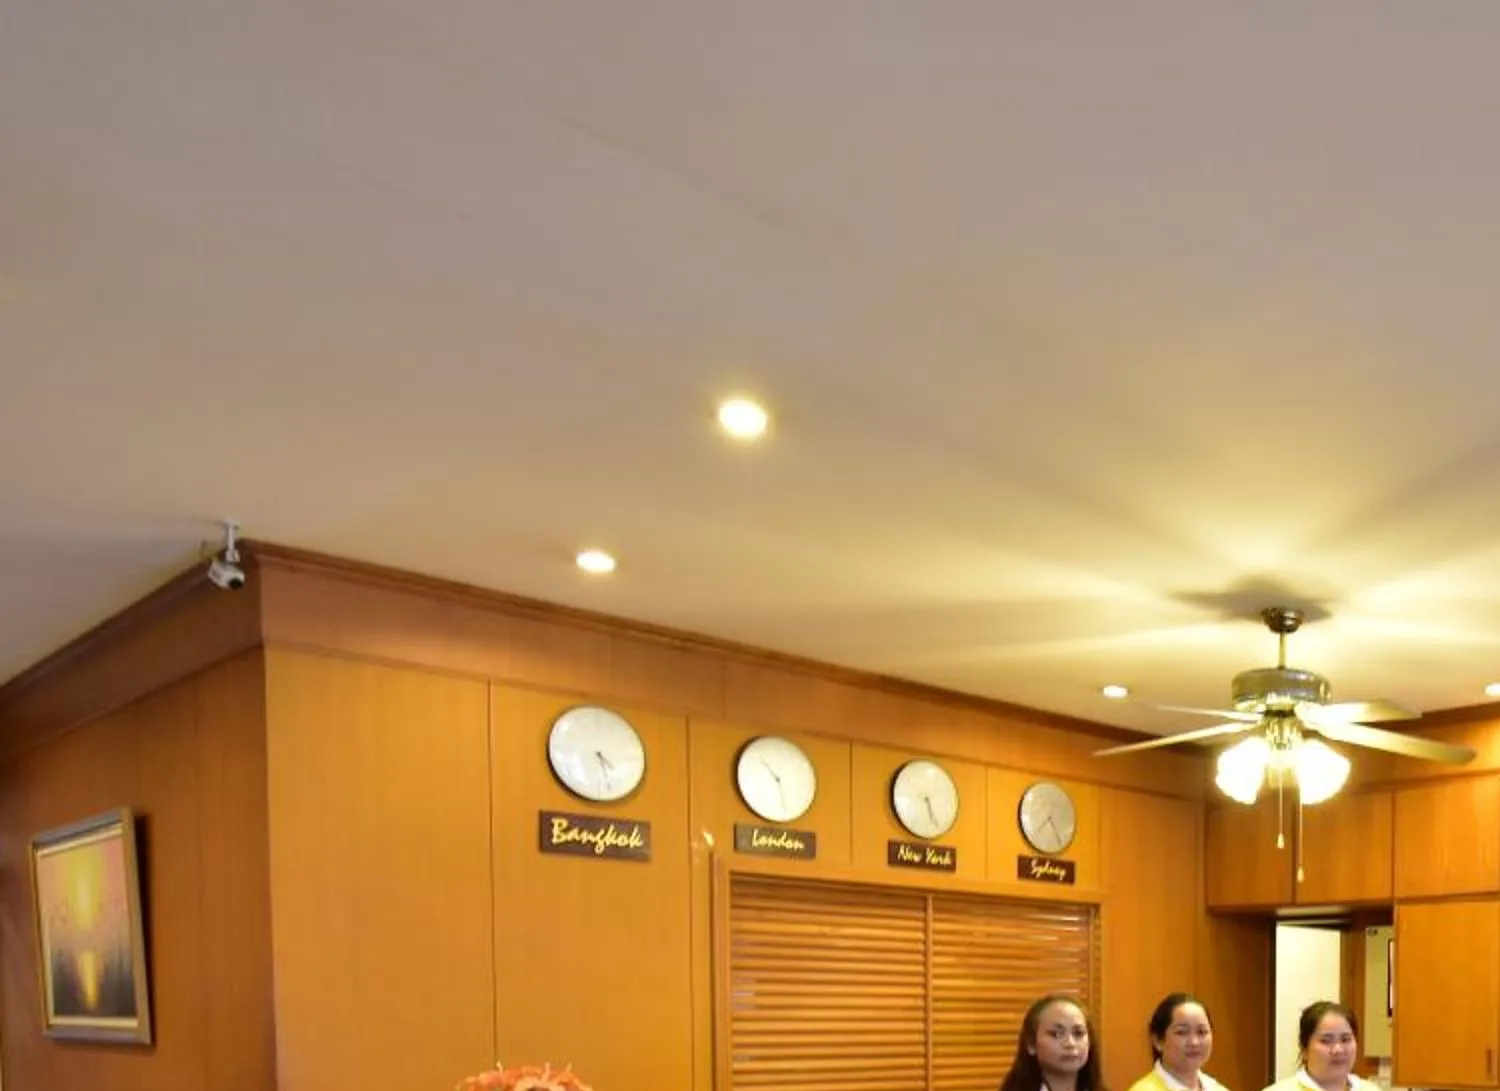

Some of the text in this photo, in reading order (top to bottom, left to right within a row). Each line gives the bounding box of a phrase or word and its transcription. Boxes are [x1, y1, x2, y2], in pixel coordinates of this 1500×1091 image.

[551, 817, 643, 853] Bangkok
[752, 829, 805, 850] London
[897, 844, 952, 866] New York
[1031, 859, 1067, 880] Sydney
